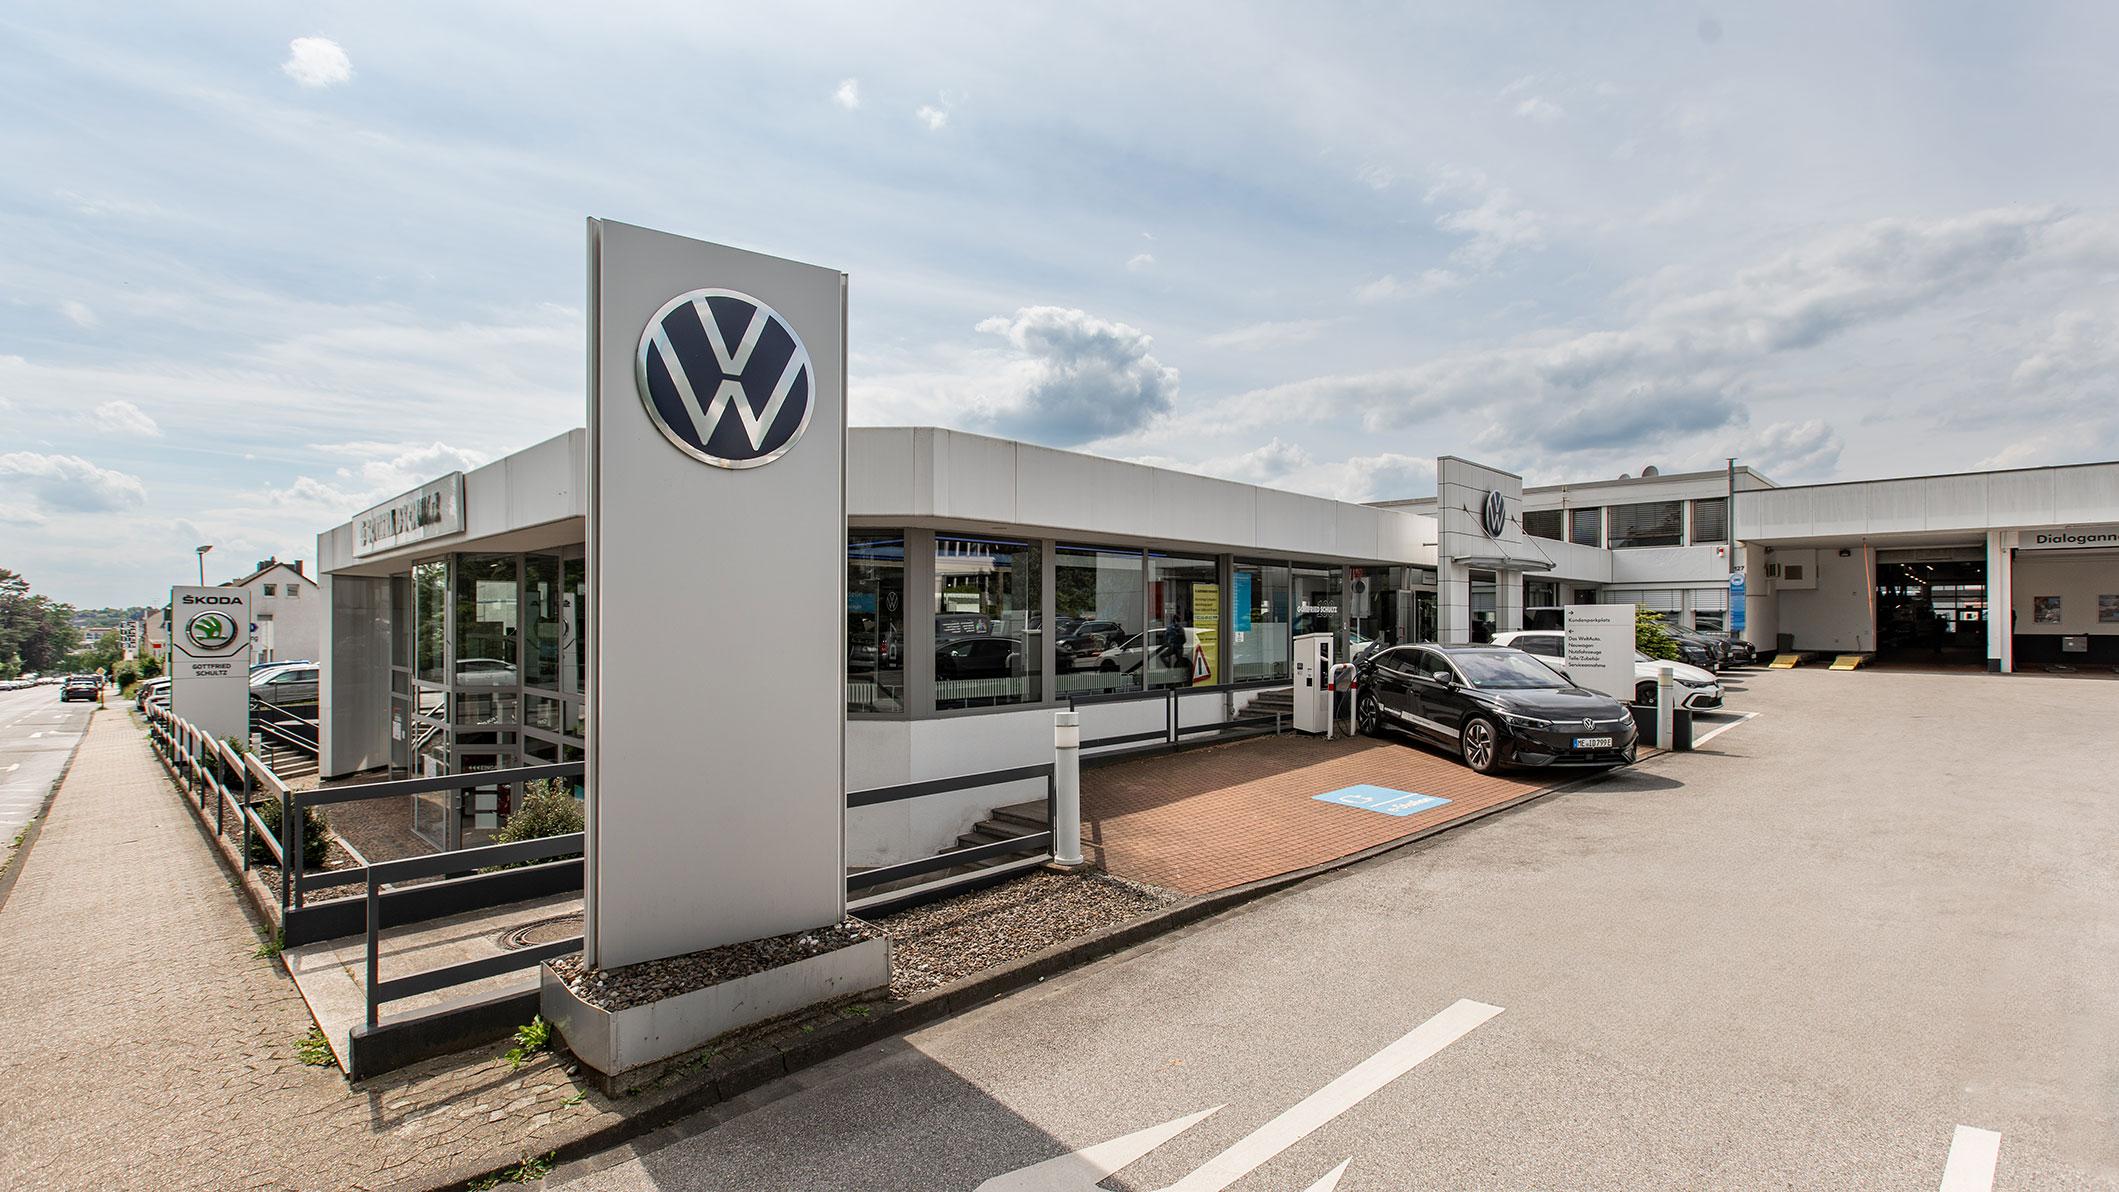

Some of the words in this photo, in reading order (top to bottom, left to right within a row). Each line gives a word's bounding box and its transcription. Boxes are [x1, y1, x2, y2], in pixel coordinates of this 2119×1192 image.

[642, 291, 810, 462] VW
[2036, 533, 2119, 545] Dialogann
[182, 594, 243, 605] ŠKODA
